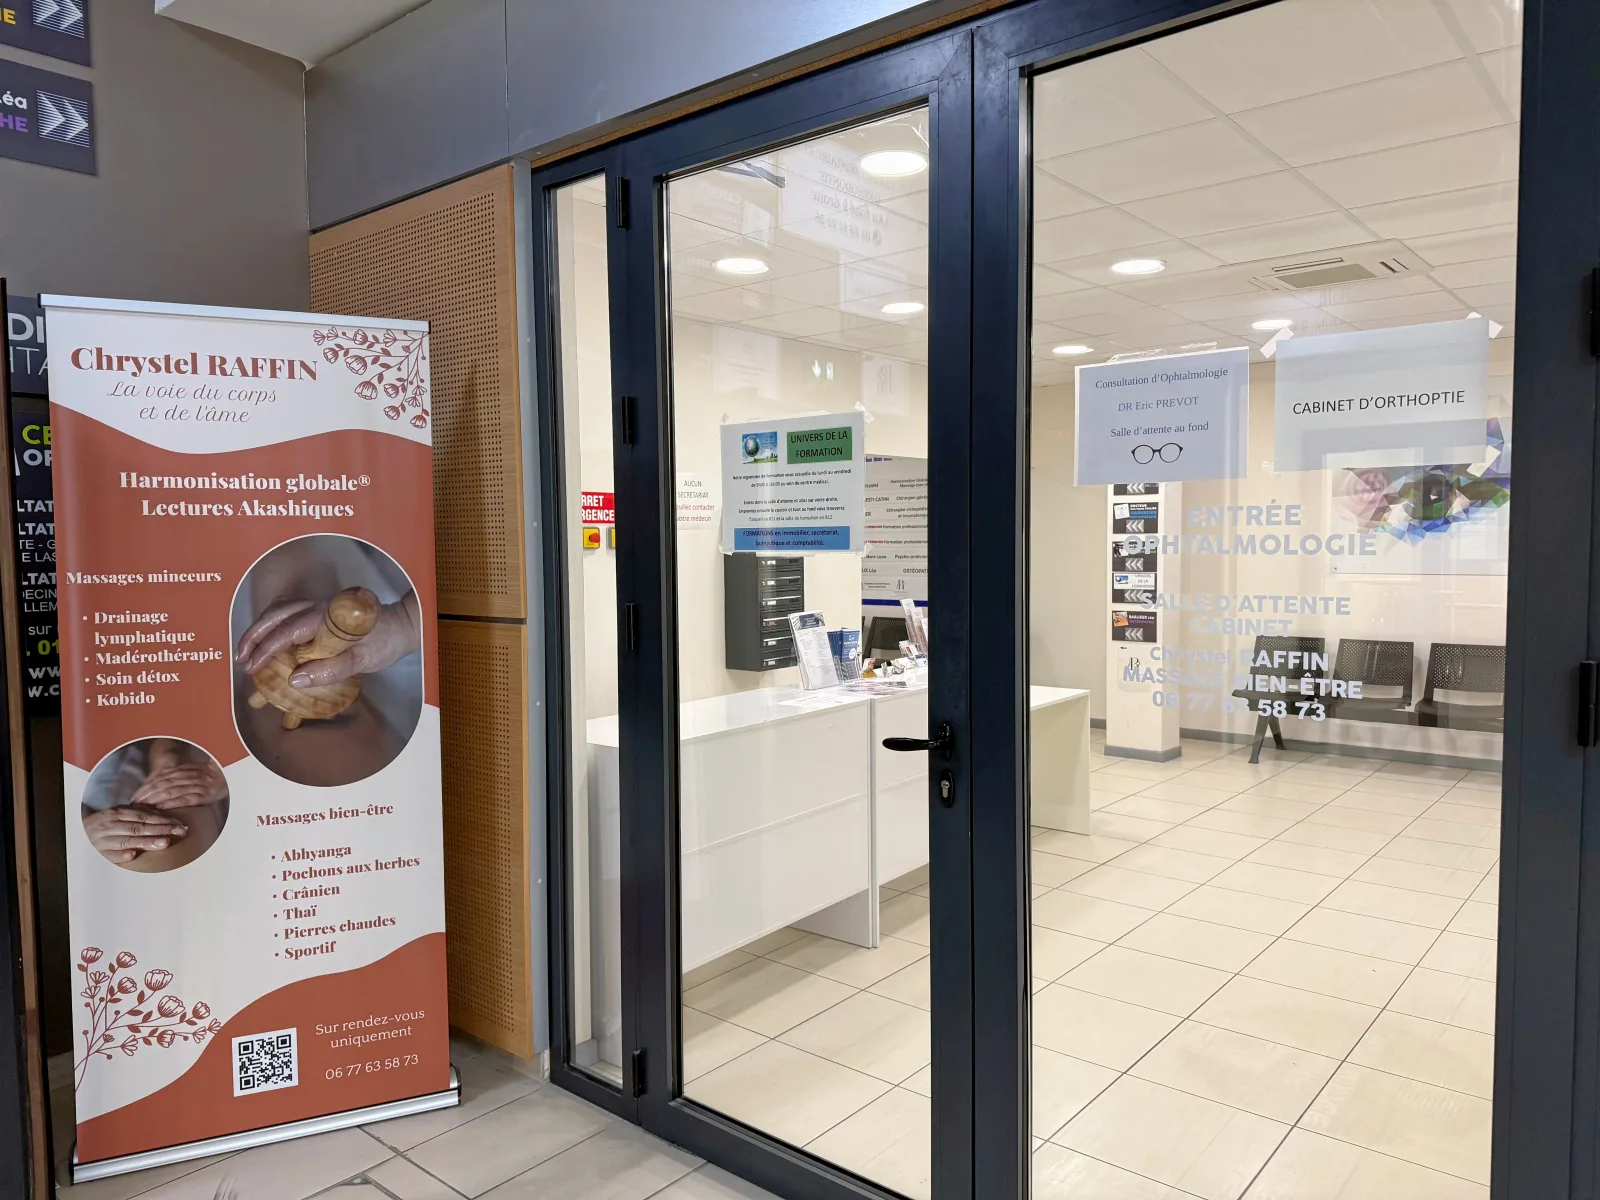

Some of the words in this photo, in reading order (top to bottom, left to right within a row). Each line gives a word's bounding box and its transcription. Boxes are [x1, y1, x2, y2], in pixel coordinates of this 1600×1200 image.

[70, 347, 200, 377] Chrystel
[206, 354, 318, 380] RAFFIN
[1095, 375, 1149, 389] Consultation
[1151, 368, 1228, 384] d'Ophtalmologie
[107, 380, 139, 397] La
[145, 382, 187, 398] voie
[193, 383, 222, 400] du
[228, 388, 276, 405] corps
[1118, 401, 1132, 412] DR
[1135, 399, 1153, 411] Eric
[1156, 396, 1200, 409] PREVOT
[1292, 398, 1355, 415] CABINET
[1359, 391, 1465, 410] D'ORTHOPTIE
[140, 405, 159, 420] et
[164, 404, 190, 421] de
[196, 405, 250, 423] l'âme
[791, 432, 823, 444] UNIVERS
[826, 431, 836, 441] DE
[839, 430, 848, 440] LA
[1110, 427, 1131, 438] Salle
[1133, 424, 1171, 436] d'attente
[1175, 424, 1184, 434] au
[1188, 421, 1208, 432] fond
[796, 446, 843, 459] FORMATION
[119, 471, 281, 491] Harmonisation
[141, 499, 233, 516] Lectures
[238, 499, 354, 519] Akashiques
[691, 514, 711, 522] médecin
[1188, 500, 1301, 528] ENTRÉE
[743, 530, 774, 538] FORMATIONS
[1123, 533, 1377, 556] OPHTALMOLOGIE
[66, 572, 144, 586] Massages
[148, 570, 222, 583] minceurs
[1140, 592, 1211, 612] SALLE
[1216, 594, 1351, 615] D'ATTENTE
[94, 610, 169, 625] Drainage
[1190, 615, 1293, 638] CABINET
[28, 626, 52, 636] sur
[95, 629, 196, 648] lymphatique
[96, 648, 222, 665] Madérothérapie
[1150, 645, 1231, 668] Chrystel
[1240, 648, 1329, 671] RAFFIN
[96, 672, 133, 686] Soin
[137, 669, 181, 684] détox
[1123, 665, 1226, 689] MASSAGE
[1234, 673, 1363, 699] BIEN-ÊTRE
[97, 691, 155, 707] Kobido
[1152, 690, 1179, 709] 06
[1186, 693, 1213, 711] 77
[1221, 695, 1251, 715] 63
[1257, 699, 1287, 718] 58
[1294, 700, 1326, 721] 73
[256, 811, 326, 827] Massages
[329, 803, 394, 820] bien-être
[281, 846, 351, 862] Abhyanga
[282, 865, 343, 882] Pochons
[346, 862, 372, 874] aux
[374, 856, 420, 871] herbes
[282, 884, 341, 901] Crânien
[283, 904, 317, 920] Thaï
[284, 924, 336, 940] Pierres
[340, 915, 396, 932] chaudes
[284, 940, 337, 960] Sportif
[315, 1023, 339, 1036] Sur
[342, 1010, 425, 1032] rendez-vous
[330, 1025, 412, 1048] uniquement
[325, 1068, 343, 1080] 06
[346, 1063, 361, 1076] 77
[365, 1060, 381, 1073] 63
[384, 1056, 400, 1070] 58
[404, 1053, 419, 1066] 73
